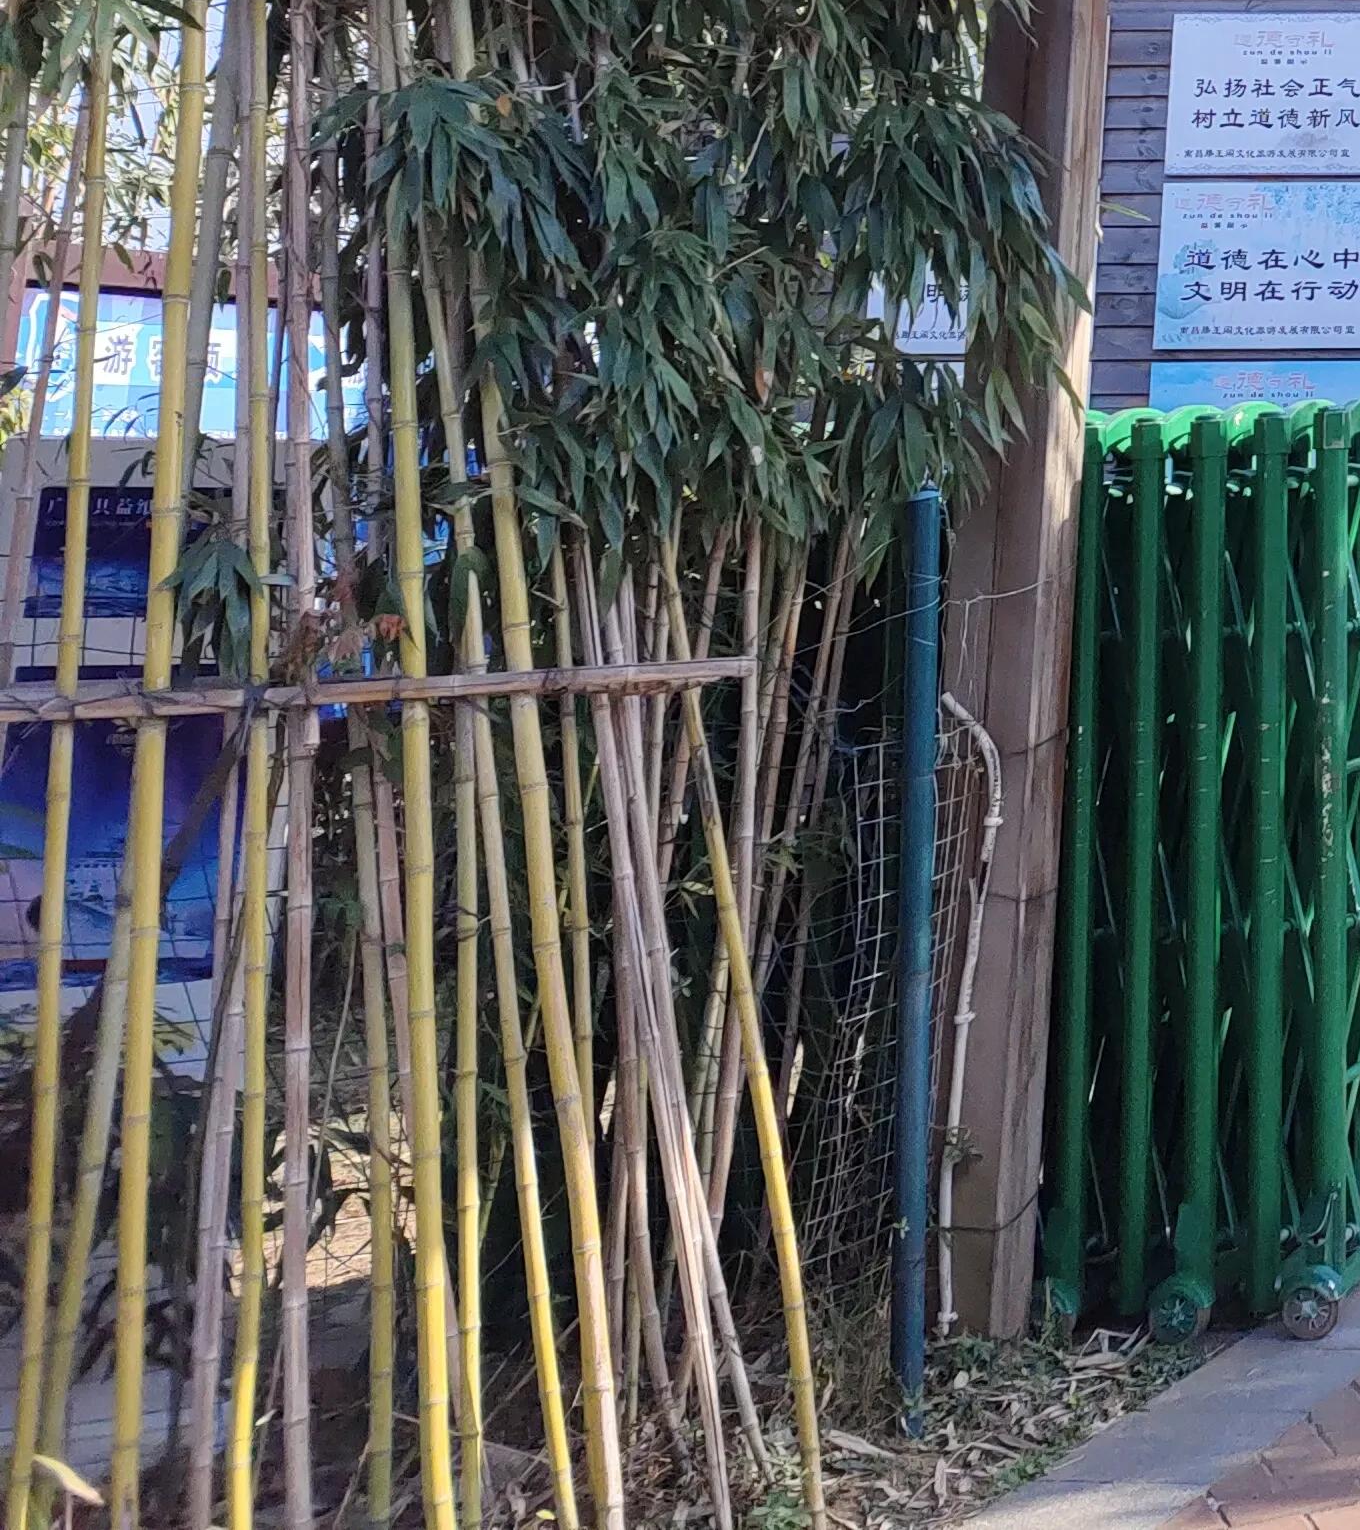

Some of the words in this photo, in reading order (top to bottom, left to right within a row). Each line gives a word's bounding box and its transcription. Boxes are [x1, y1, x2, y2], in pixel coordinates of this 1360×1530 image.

[1192, 108, 1360, 129] 树立道德新风
[1184, 248, 1360, 270] 道德在心中
[1180, 280, 1360, 301] 文明在行动
